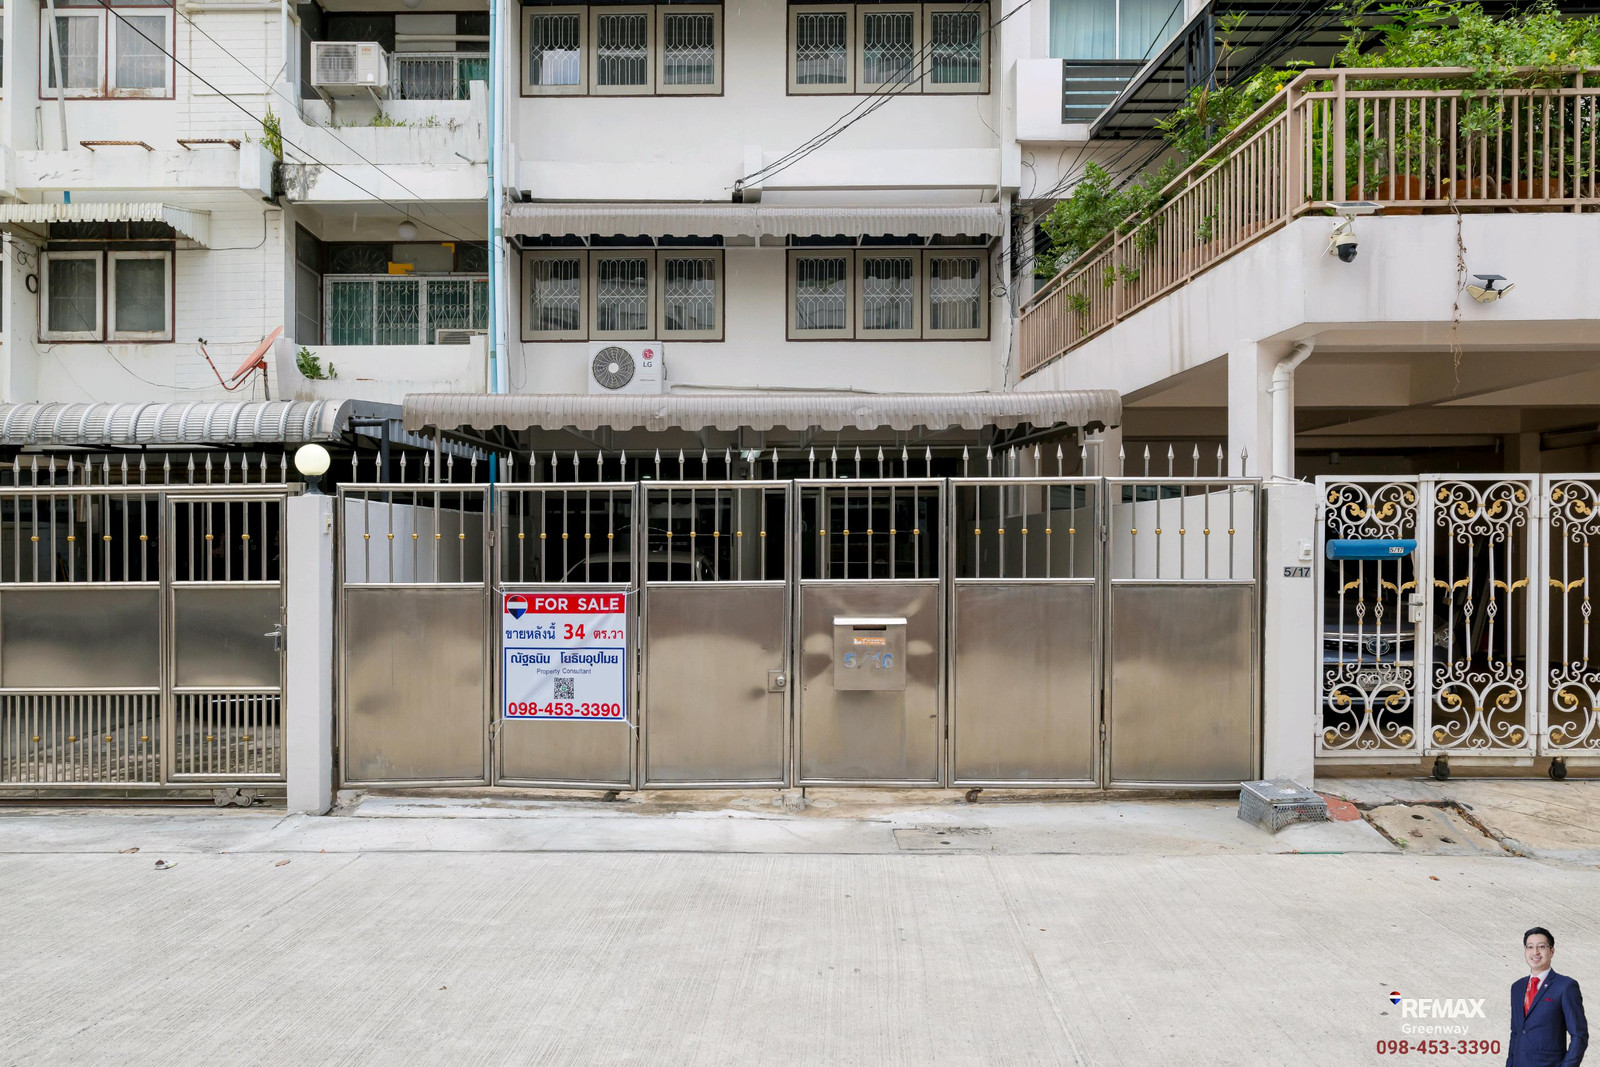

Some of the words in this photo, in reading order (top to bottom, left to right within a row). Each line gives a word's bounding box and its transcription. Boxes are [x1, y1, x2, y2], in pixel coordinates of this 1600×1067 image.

[1284, 567, 1311, 577] 5/17
[535, 598, 568, 611] FOR
[578, 598, 619, 611] SALE
[505, 622, 556, 640] ขายหลังนี้
[563, 624, 585, 640] 34
[593, 629, 624, 640] ตร.วา
[844, 652, 894, 669] 5/16
[508, 702, 620, 717] 098-453-3390
